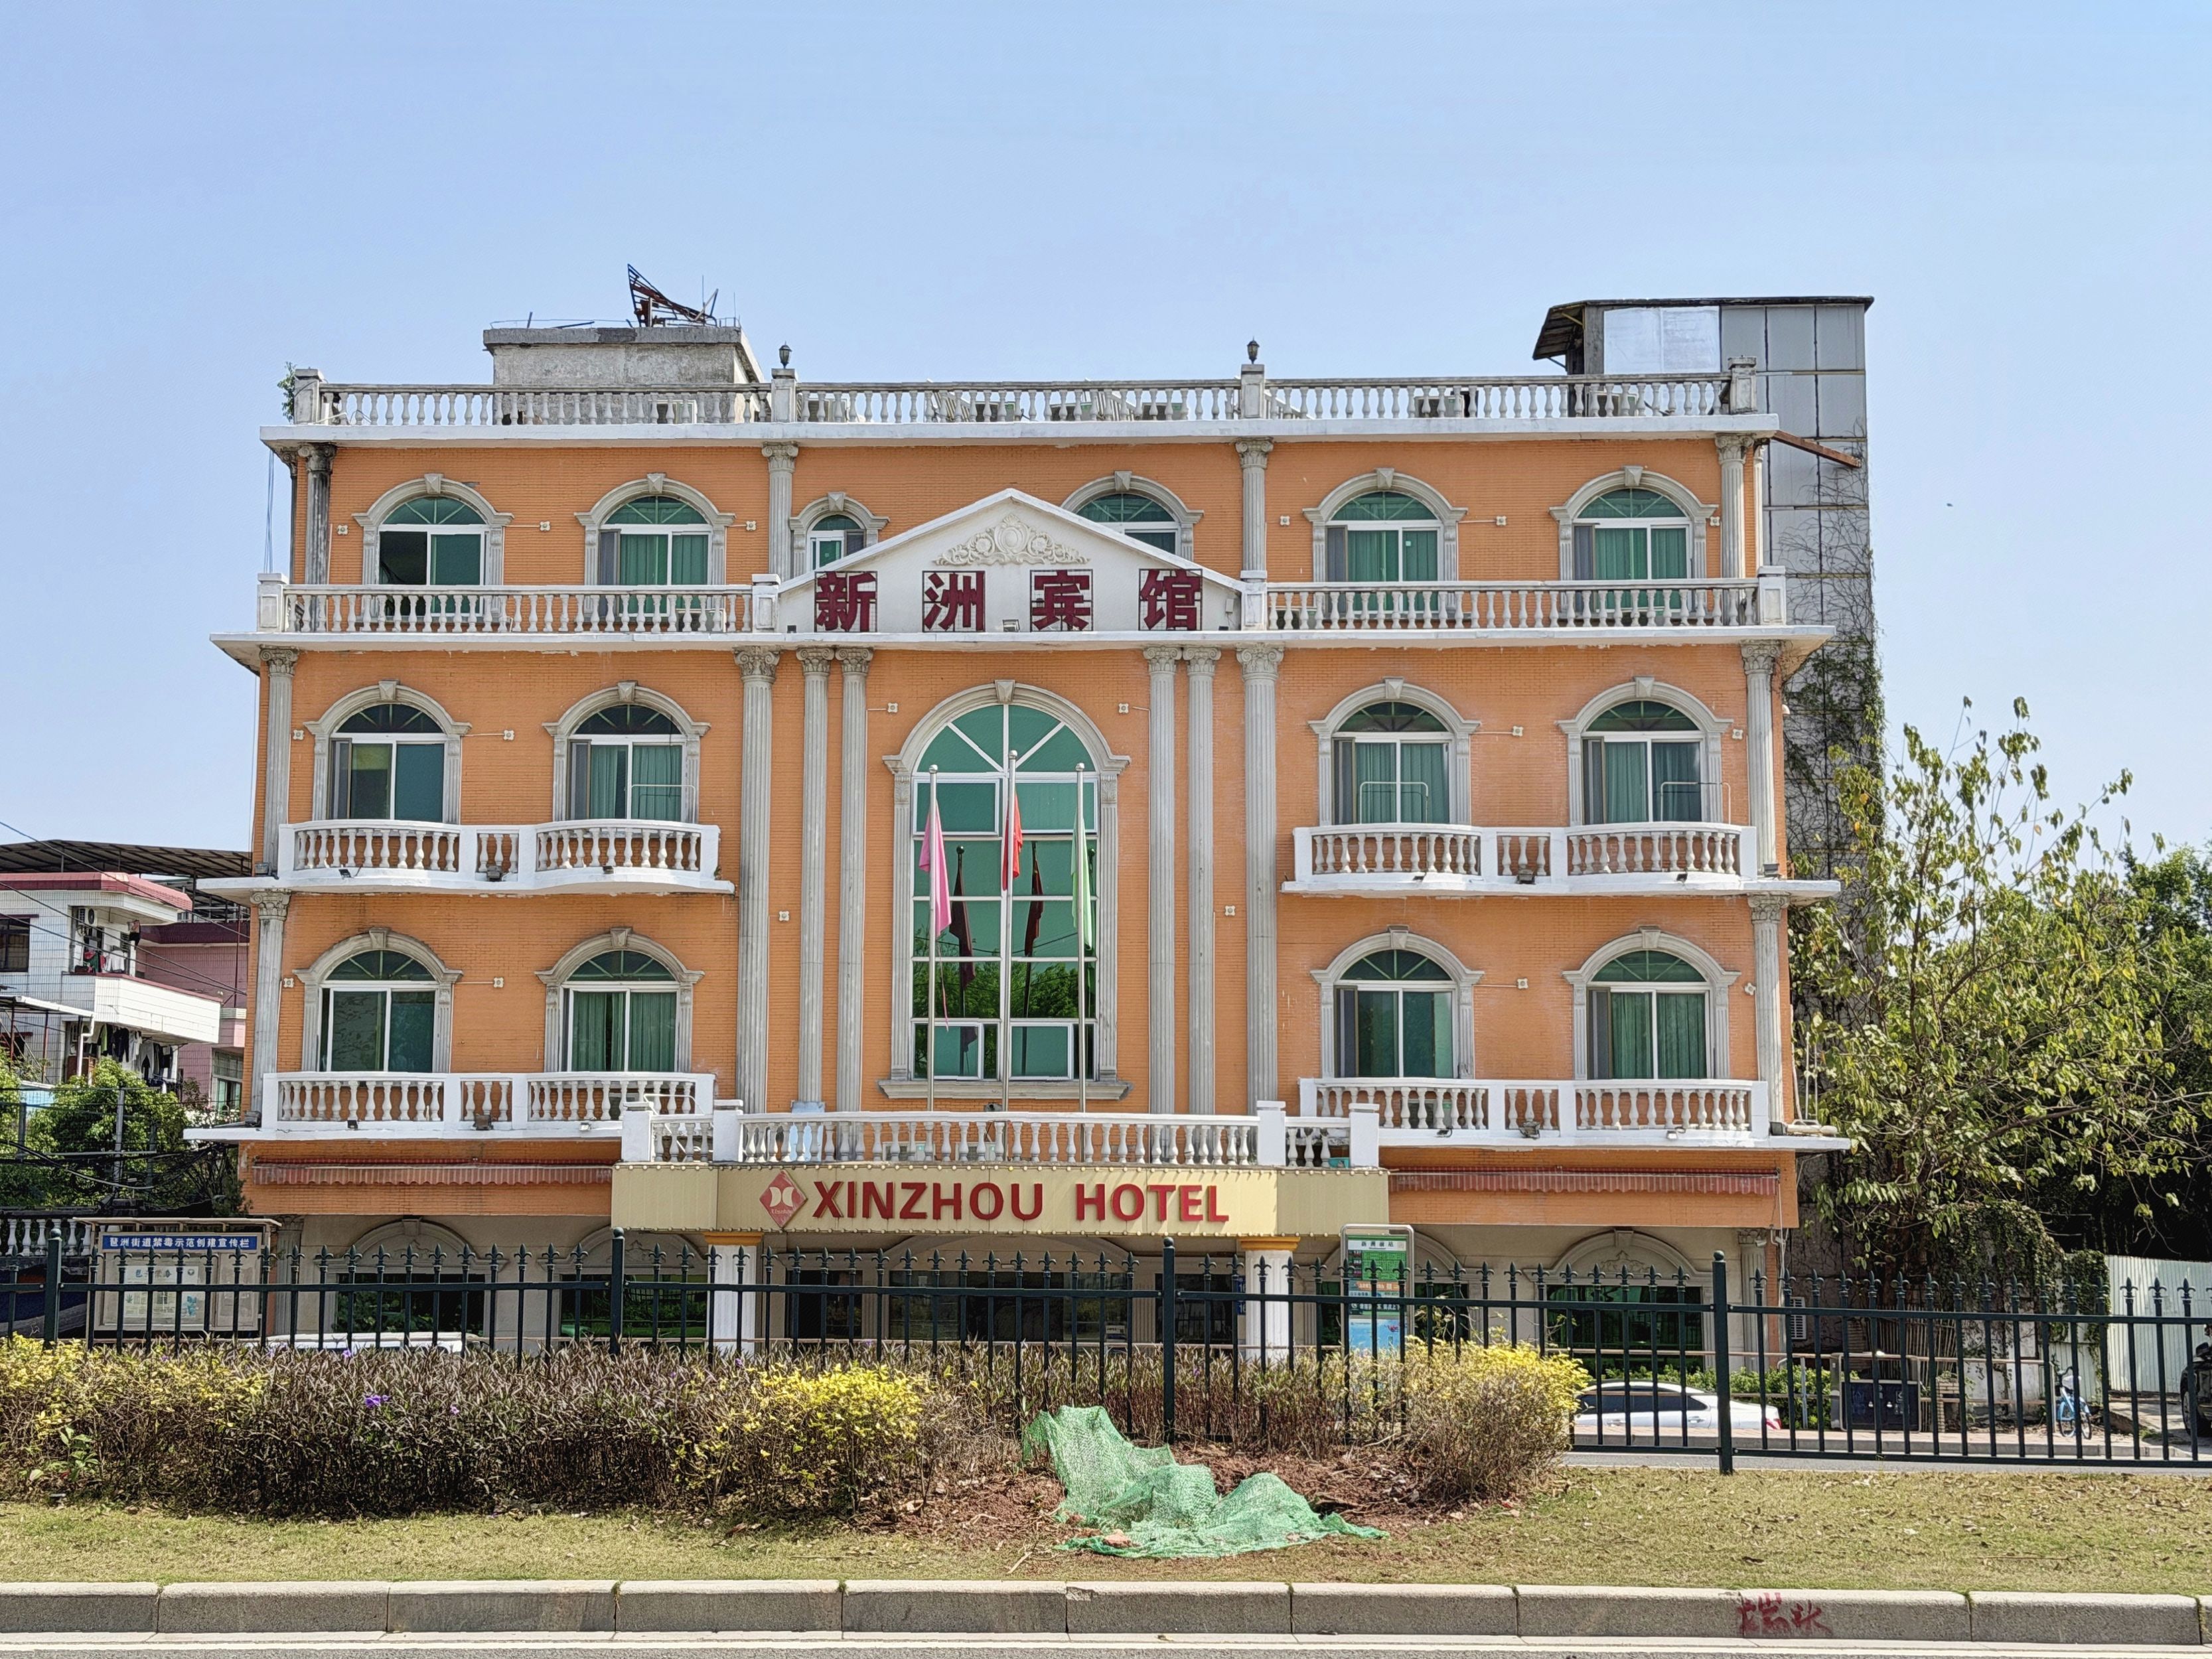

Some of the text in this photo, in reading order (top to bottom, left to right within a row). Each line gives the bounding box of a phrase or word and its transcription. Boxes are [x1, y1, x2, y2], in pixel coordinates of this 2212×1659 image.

[816, 569, 1201, 631] 新洲宾馆
[813, 1182, 1228, 1222] XINZHOU HOTEL
[110, 1237, 250, 1248] 琶洲街道禁毒示范创建宣传栏
